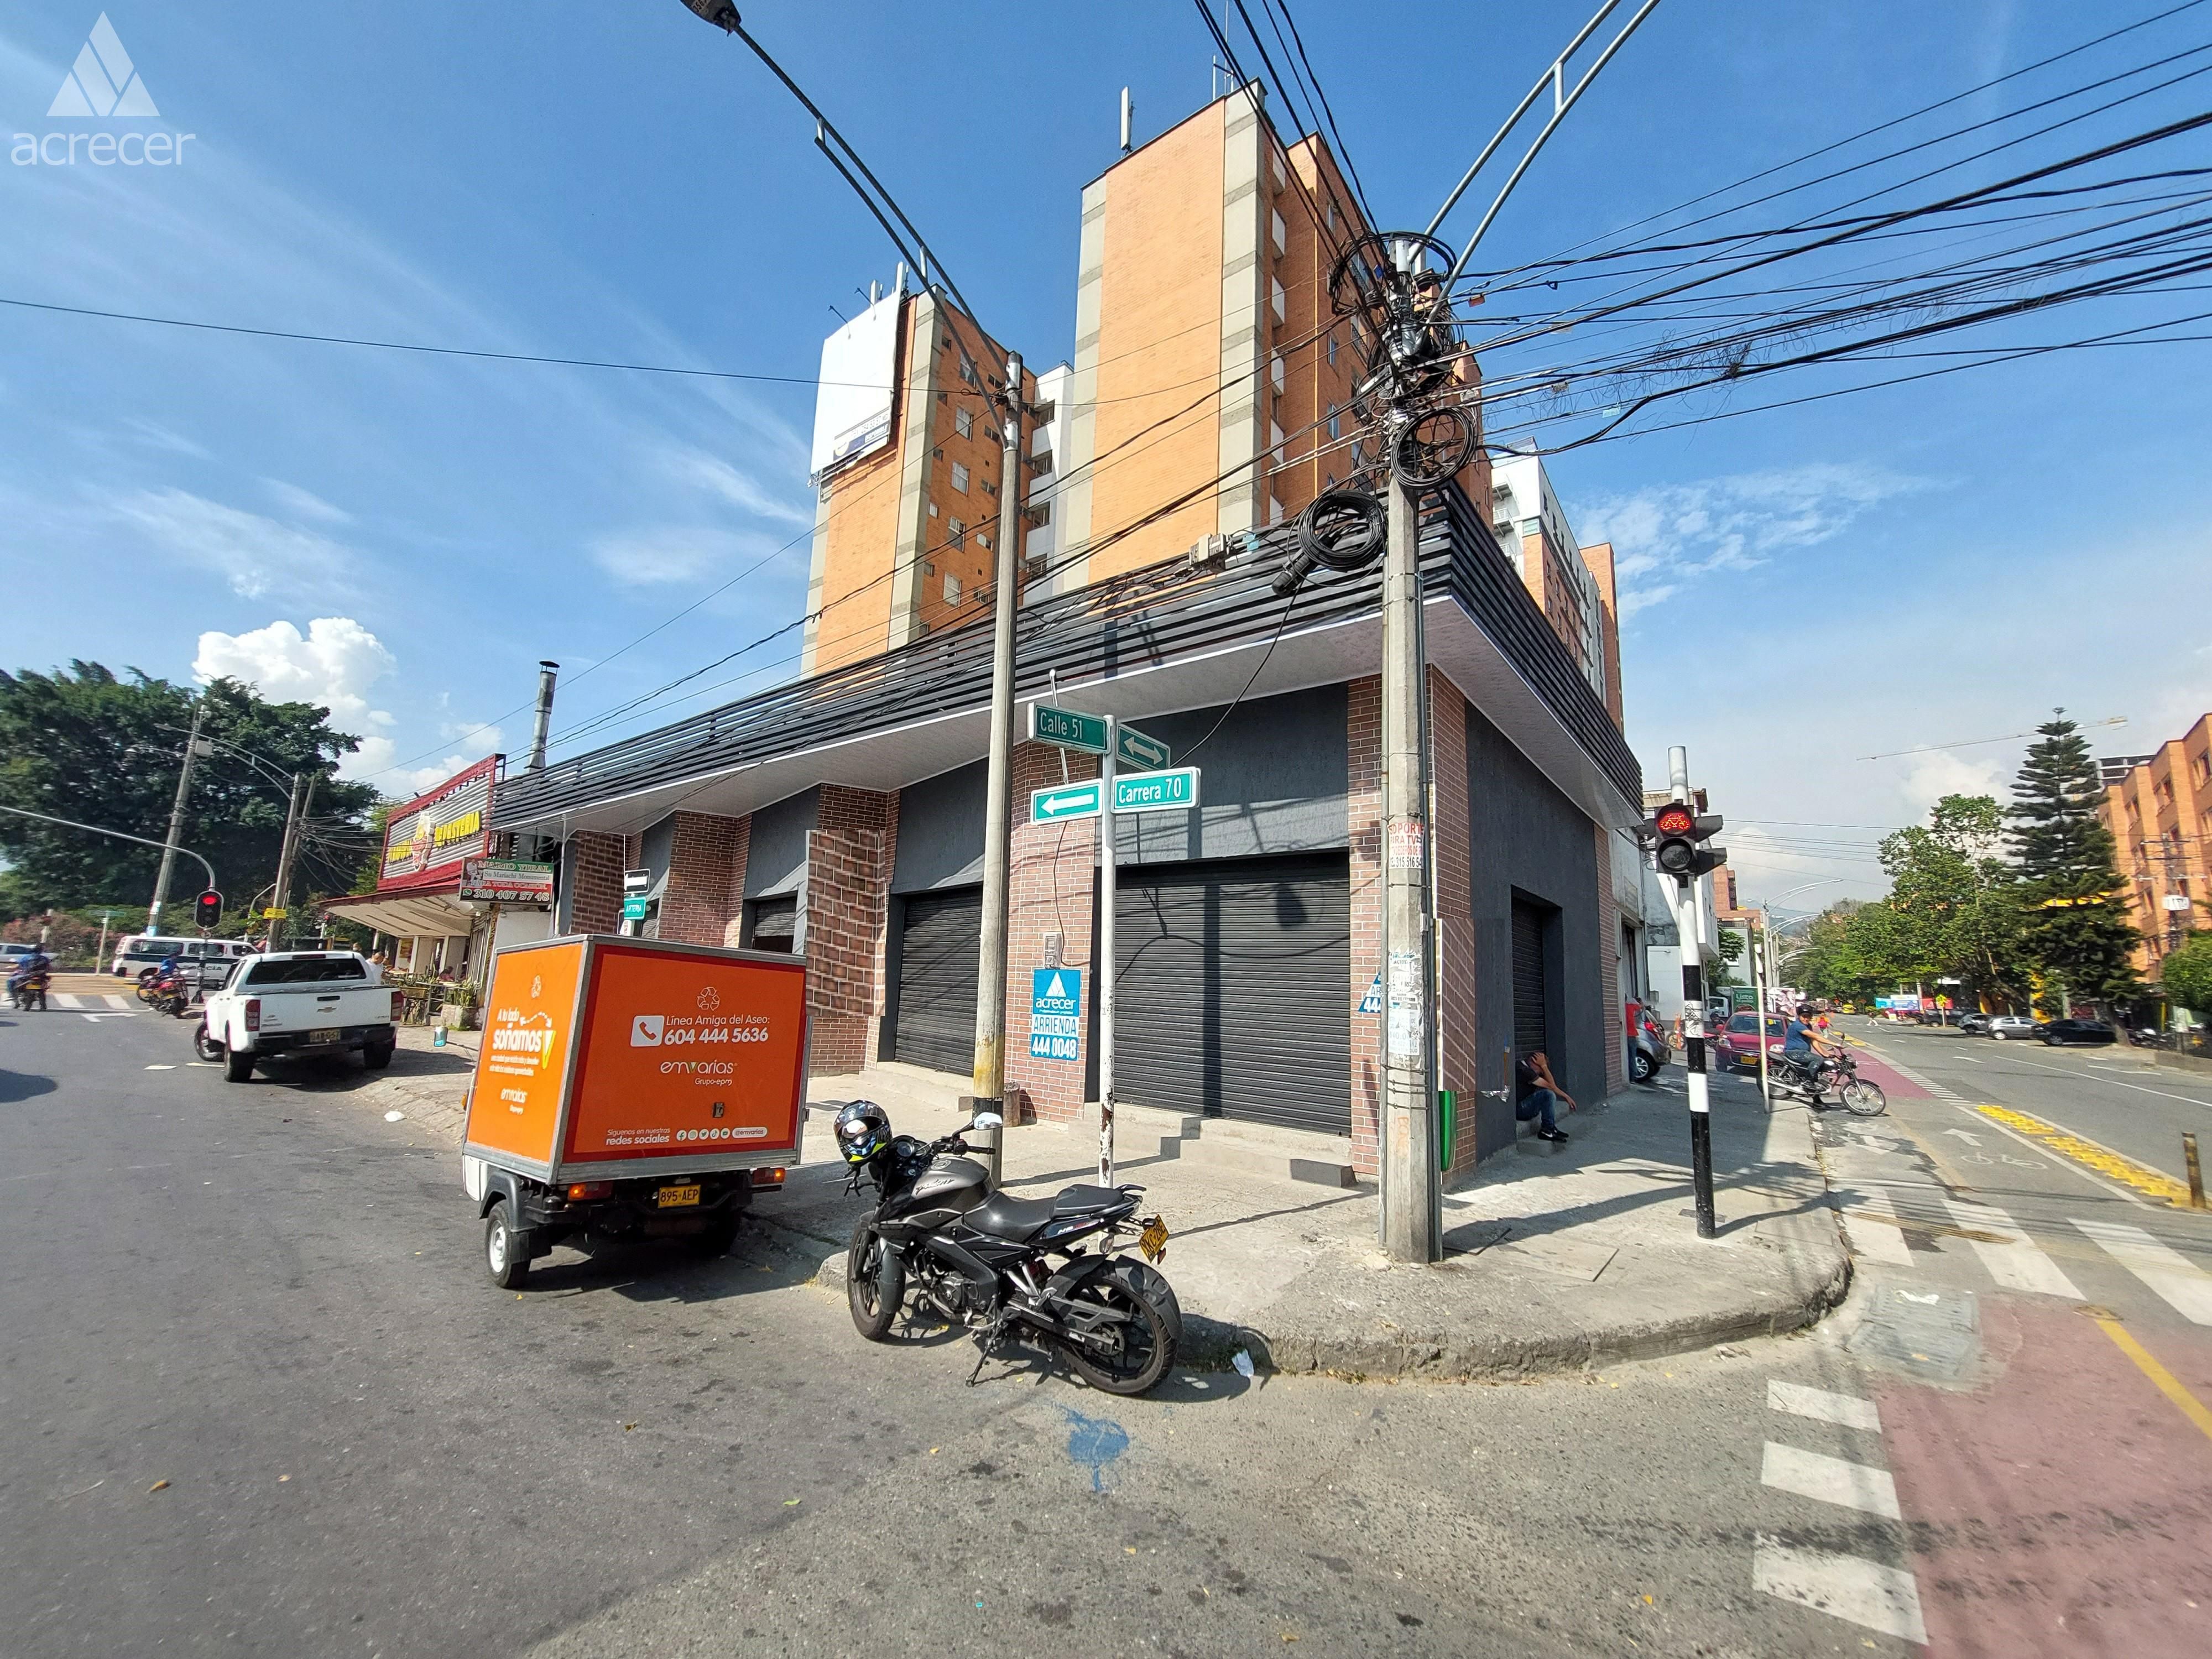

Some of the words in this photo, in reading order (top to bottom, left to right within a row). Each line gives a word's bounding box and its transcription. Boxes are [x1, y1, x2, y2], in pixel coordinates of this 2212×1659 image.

[1040, 712, 1068, 736] Calle
[1072, 718, 1083, 739] 51
[1119, 784, 1161, 804] Carrera
[1165, 776, 1182, 797] 70
[518, 873, 550, 881] Monumental
[473, 889, 494, 899] 310
[495, 890, 518, 900] 407
[519, 892, 534, 901] 57
[535, 892, 550, 901] 48
[1035, 998, 1076, 1010] acrecer
[497, 1009, 502, 1021] A
[666, 1015, 692, 1026] Línea
[695, 1015, 726, 1027] Amiga
[729, 1014, 743, 1024] del
[745, 1014, 770, 1024] Aseo:
[1034, 1016, 1076, 1035] ARRIENDA
[493, 1022, 542, 1052] soñamos
[664, 1029, 695, 1045] 604
[698, 1027, 728, 1044] 444
[731, 1027, 769, 1043] 5636
[1032, 1036, 1051, 1056] 444
[1051, 1037, 1077, 1059] 0048
[660, 1060, 733, 1074] emvarias
[606, 1135, 633, 1145] redes
[634, 1134, 670, 1144] sociales
[607, 1129, 635, 1137] Síguenos
